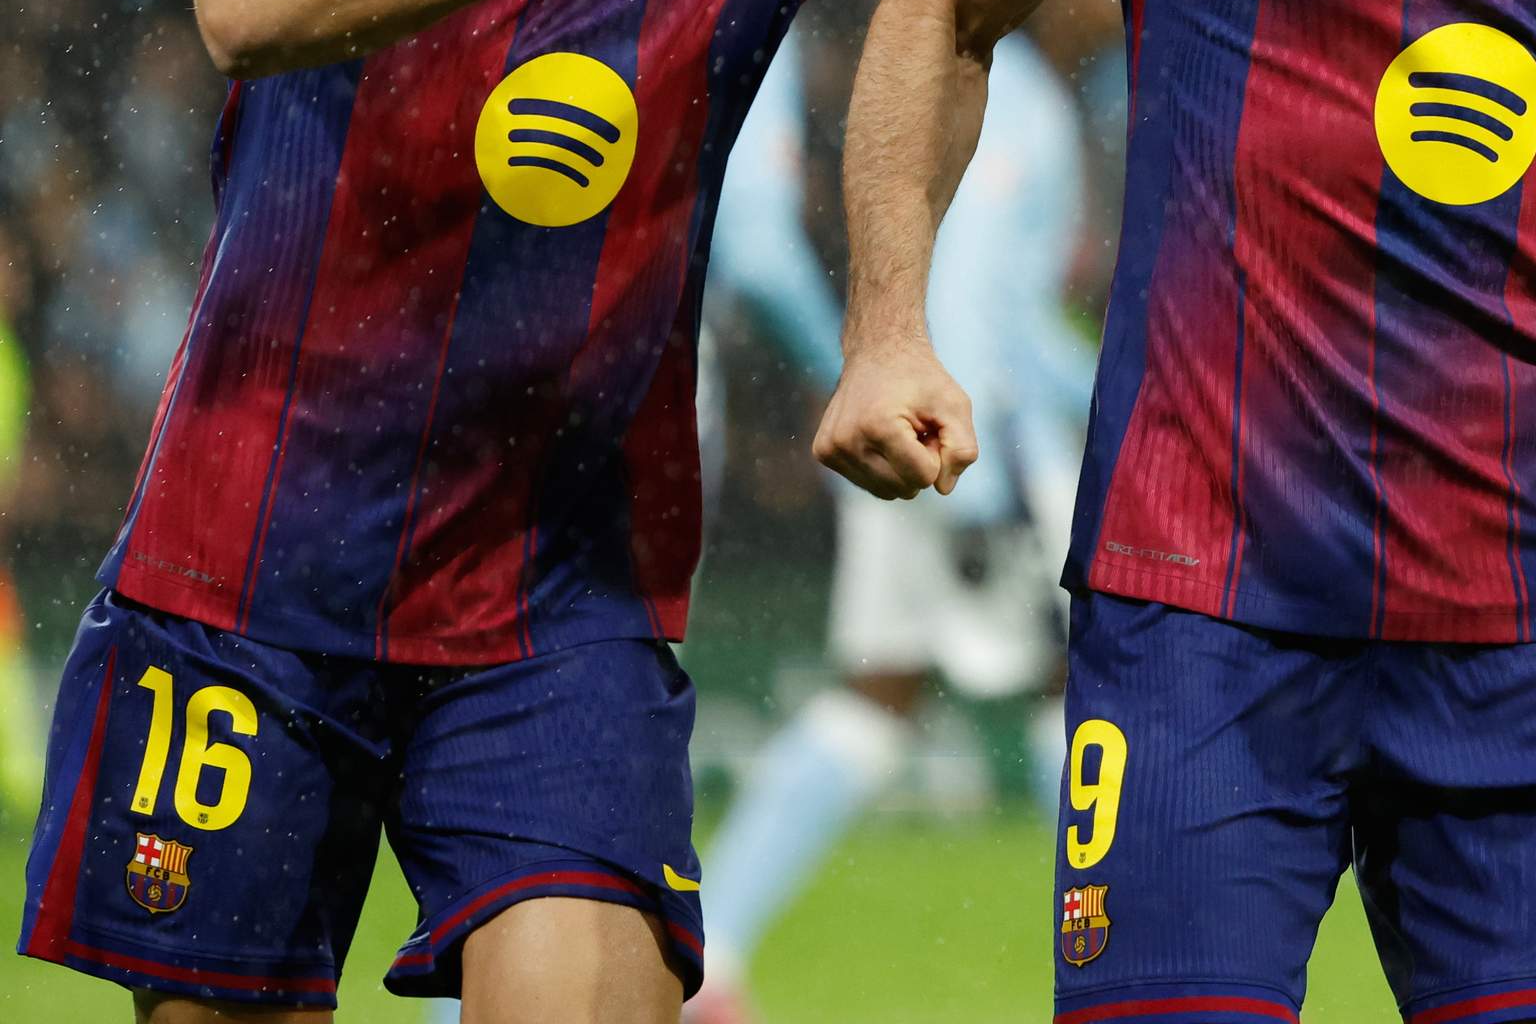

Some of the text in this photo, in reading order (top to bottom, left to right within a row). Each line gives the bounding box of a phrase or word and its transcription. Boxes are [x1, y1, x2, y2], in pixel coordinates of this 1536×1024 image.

[130, 664, 258, 831] 16
[1066, 719, 1128, 870] 9
[146, 866, 170, 880] FCB
[1071, 918, 1090, 931] FCB
